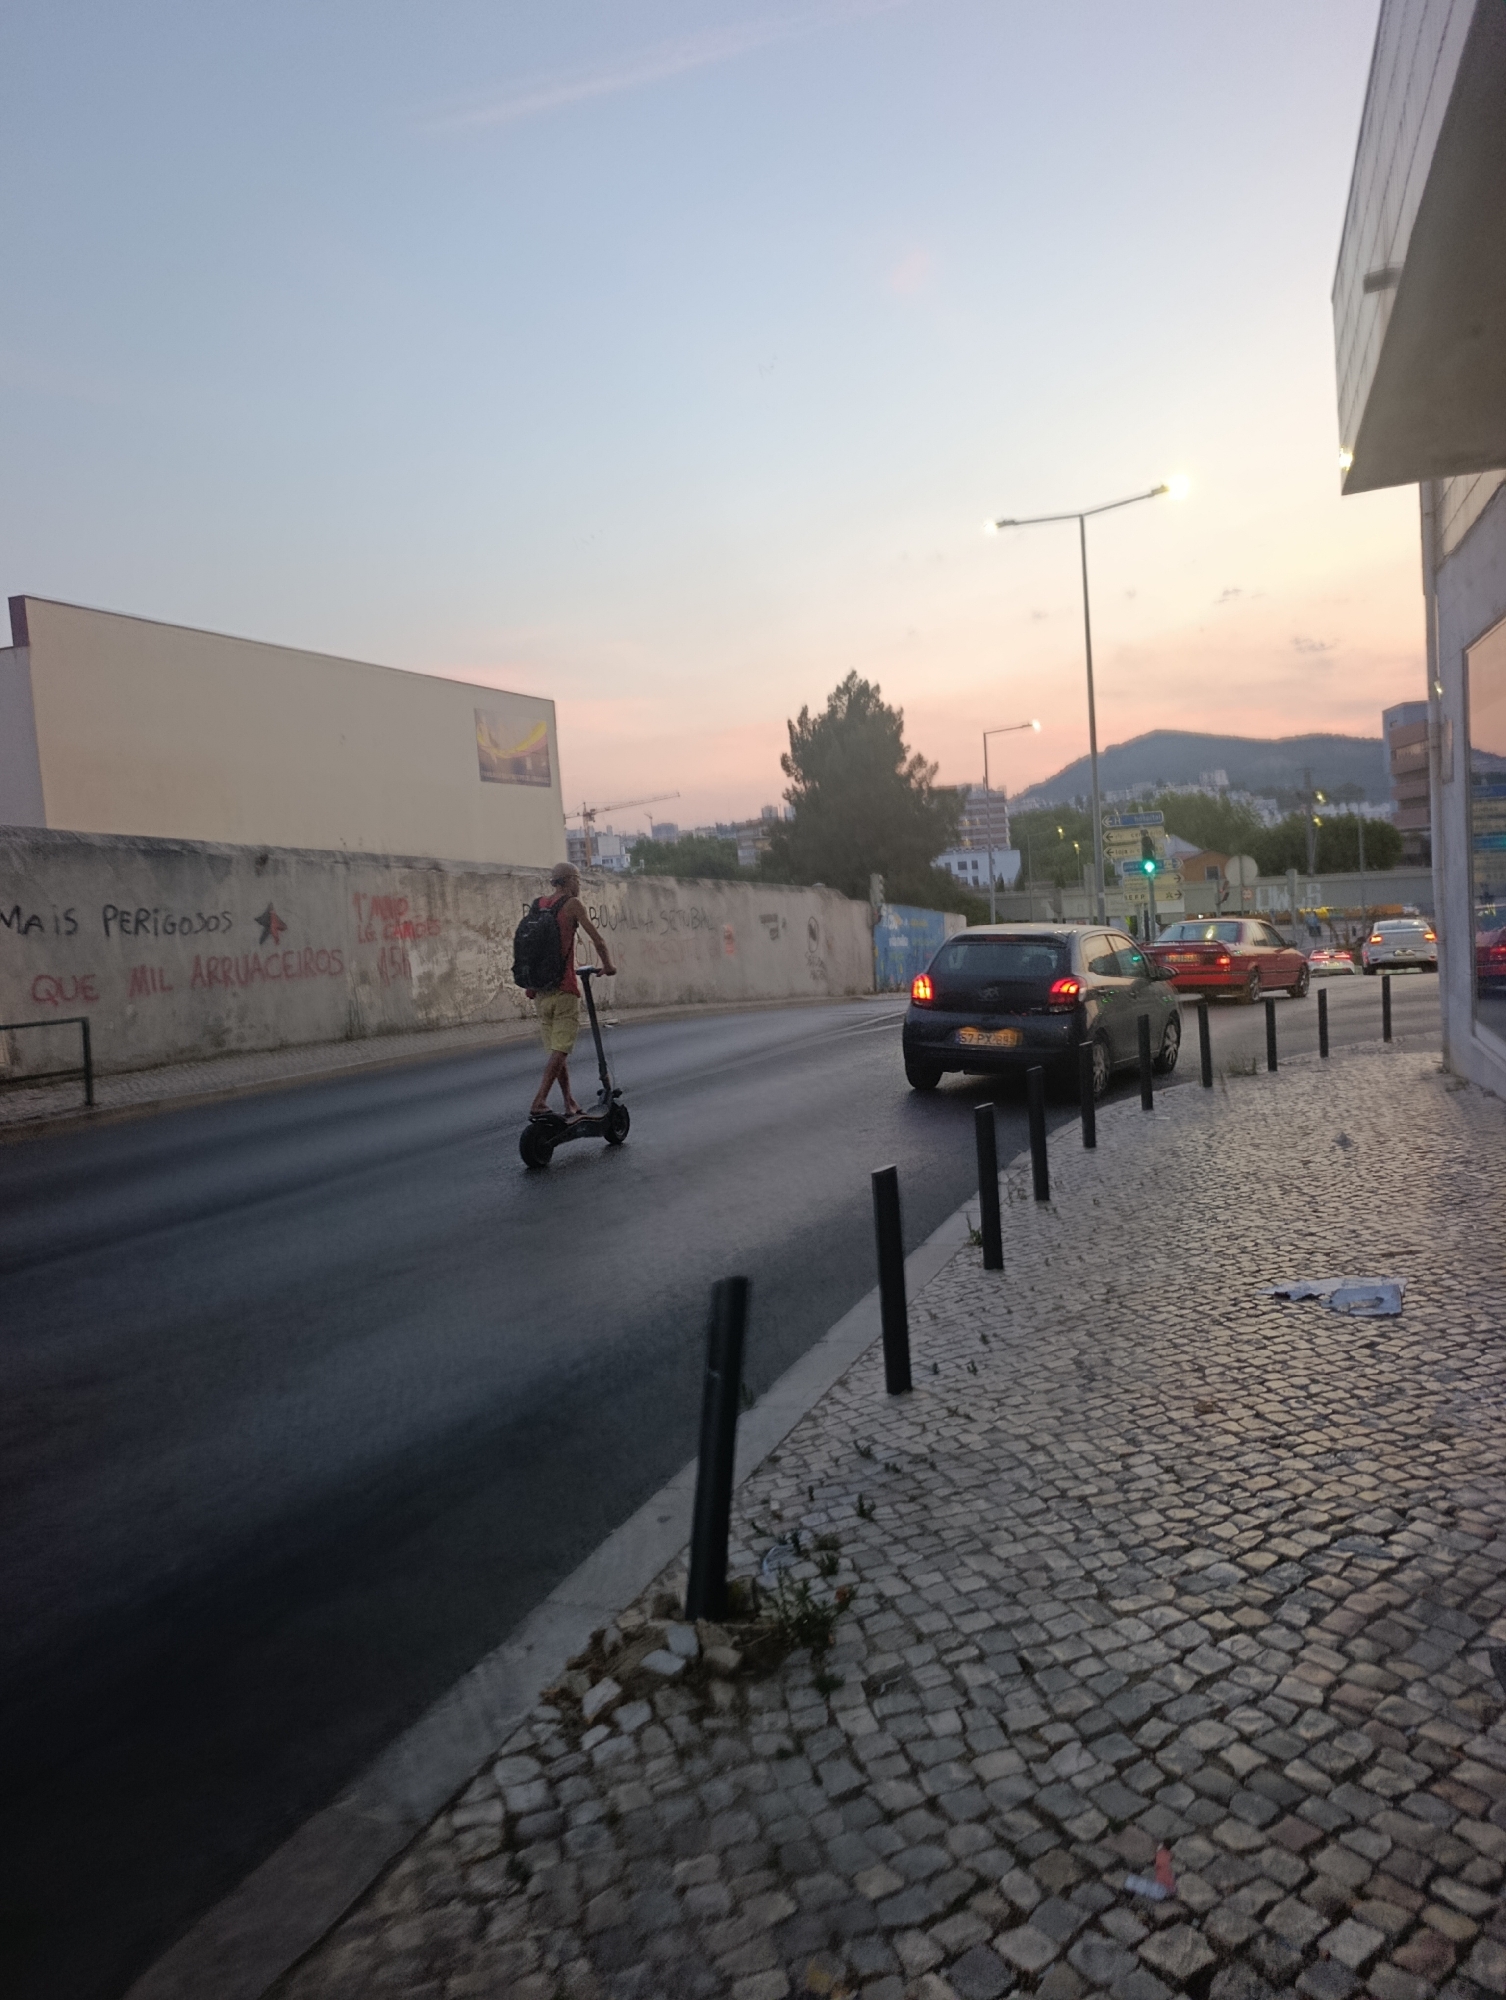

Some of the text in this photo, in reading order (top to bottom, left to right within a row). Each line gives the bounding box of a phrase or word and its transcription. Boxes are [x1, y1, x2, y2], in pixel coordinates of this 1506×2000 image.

[31, 946, 345, 1006] QUE MIL ARRUACEIROS
